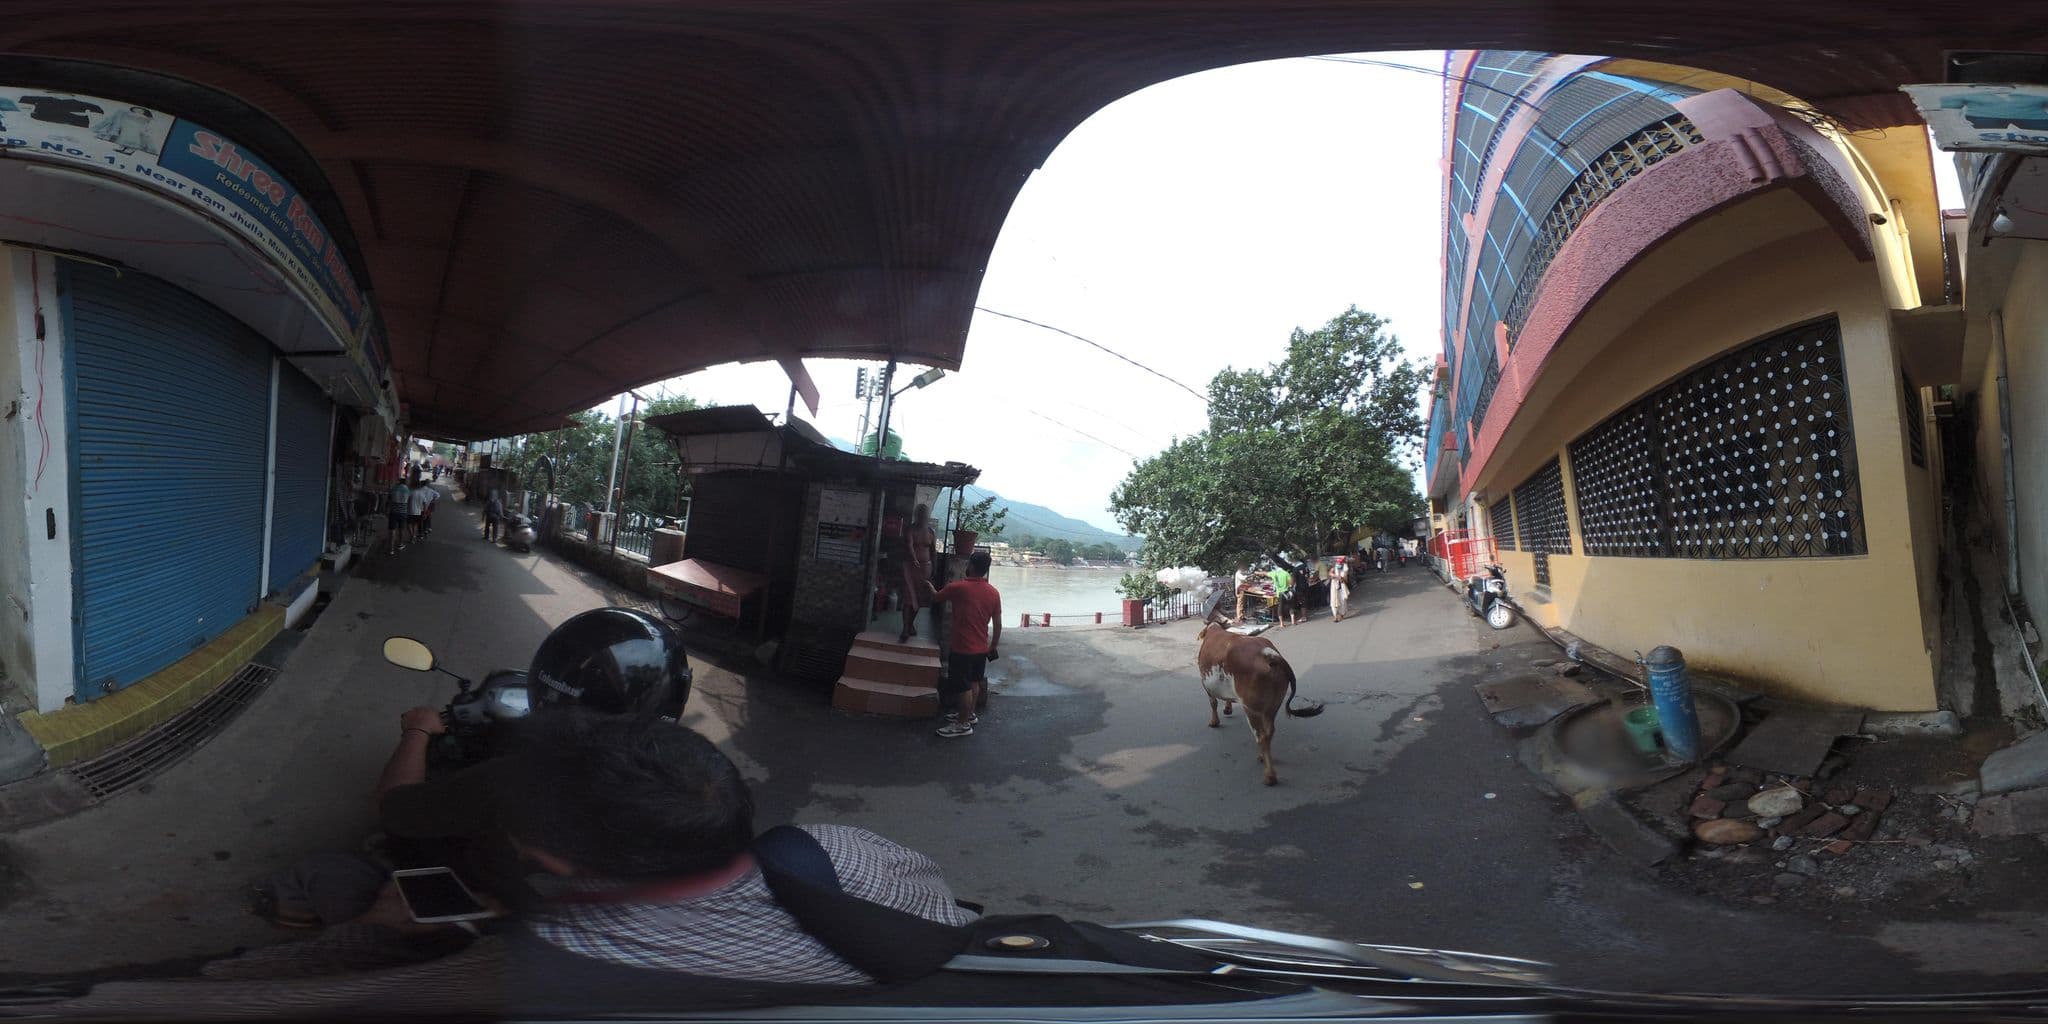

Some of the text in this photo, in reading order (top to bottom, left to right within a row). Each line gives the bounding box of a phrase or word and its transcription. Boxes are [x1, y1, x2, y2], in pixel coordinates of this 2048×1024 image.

[41, 141, 92, 158] No.
[104, 155, 126, 169] 1,
[136, 163, 187, 189] Near
[191, 187, 226, 213] Ram
[229, 210, 266, 243] Jhulla,
[189, 131, 286, 207] Shree
